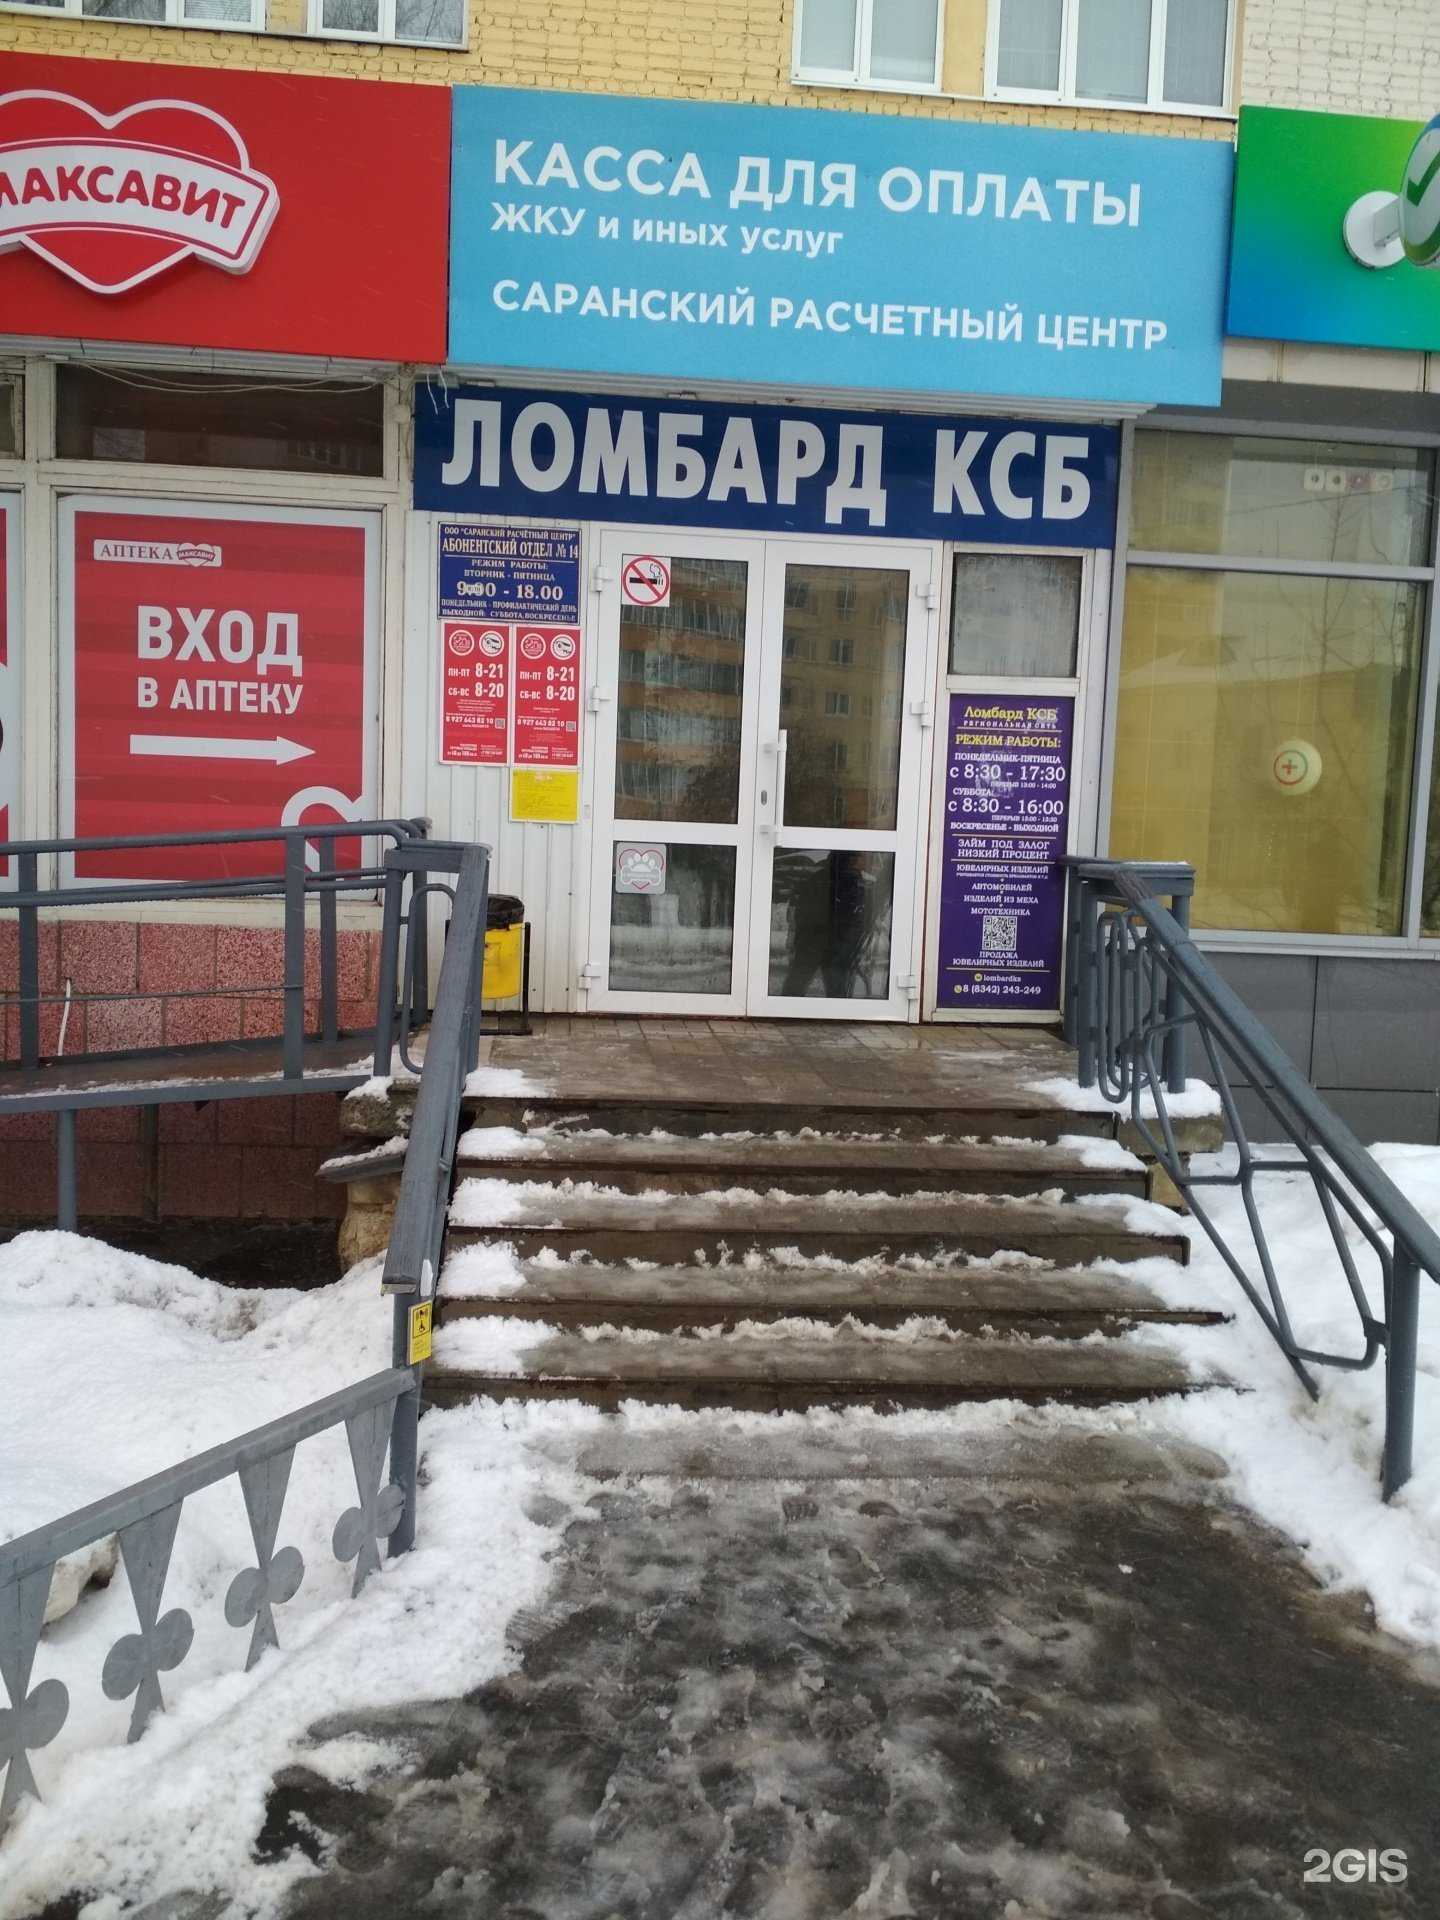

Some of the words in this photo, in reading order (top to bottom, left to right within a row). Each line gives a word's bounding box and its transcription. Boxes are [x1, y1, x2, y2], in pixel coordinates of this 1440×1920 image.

[495, 139, 711, 198] КАССА
[729, 156, 856, 211] ДЛЯ
[879, 167, 1140, 227] ОПЛАТЫ
[490, 202, 586, 236] ЖКУ
[599, 216, 619, 240] и
[632, 219, 728, 247] иных
[740, 226, 843, 258] услуг
[493, 279, 754, 326] САРАНСКИЙ
[770, 297, 1023, 342] РАСЧЕТНЫЙ
[1037, 314, 1168, 351] ЦЕНТР
[442, 398, 887, 527] ЛОМБАРД
[933, 429, 1091, 521] КСБ
[444, 526, 460, 534] ООО
[100, 544, 174, 560] АПТЕКА
[442, 538, 517, 555] АБОНЕНТСКИЙ
[520, 542, 552, 558] ОТДЕЛ
[556, 545, 566, 558] №
[569, 545, 579, 558] 14
[472, 559, 506, 568] РЕЖИМ
[464, 570, 506, 578] ВТОРНИК
[513, 572, 556, 581] ПЯТНИЦА
[516, 584, 564, 600] 18.00
[441, 599, 488, 608] ПОНЕДЕЛЬНИК
[560, 604, 577, 613] ДЕНЬ
[138, 605, 303, 677] ВХОД
[448, 667, 470, 677] ПН-ПТ
[475, 662, 504, 678] 8-21
[520, 672, 542, 680] ПН-ПТ
[546, 666, 574, 682] 8-21
[138, 677, 158, 708] В
[170, 679, 304, 715] АПТЕКУ
[475, 682, 504, 698] 8-20
[546, 686, 576, 702] 8-20
[964, 706, 1024, 721] Ломбард
[1026, 707, 1058, 720] КСБ
[955, 734, 1004, 746] РЕЖИМ
[1006, 736, 1062, 748] РАБОТЫ:
[964, 764, 1001, 780] 8:30
[1020, 766, 1066, 782] 17:30
[962, 798, 1000, 813] 8:30
[1018, 800, 1064, 816] 16:00
[950, 822, 1008, 831] ВОСКРЕСЕНЬЕ
[1014, 823, 1059, 833] ВЫХОДНОЙ
[958, 838, 986, 848] ЗАЙМ
[991, 840, 1014, 850] ПОД
[1018, 841, 1050, 850] ЗАЛОГ
[957, 848, 1000, 858] НИЗКИЙ
[1002, 850, 1050, 860] ПРОЦЕНТ
[956, 864, 1010, 872] ЮВЕЛИРНЫХ
[1010, 866, 1049, 874] ИЗДЕЛИЙ
[972, 883, 1032, 892] АВТОМОБИЛЕЙ
[964, 894, 1002, 902] ИЗДЕЛИЙ
[970, 908, 1031, 916] МОТОТЕХНИКА
[952, 958, 1005, 966] ЮВЕЛИРНЫХ
[962, 984, 969, 993] 8
[971, 984, 1000, 996] (8342)
[1002, 986, 1042, 995] 243-249
